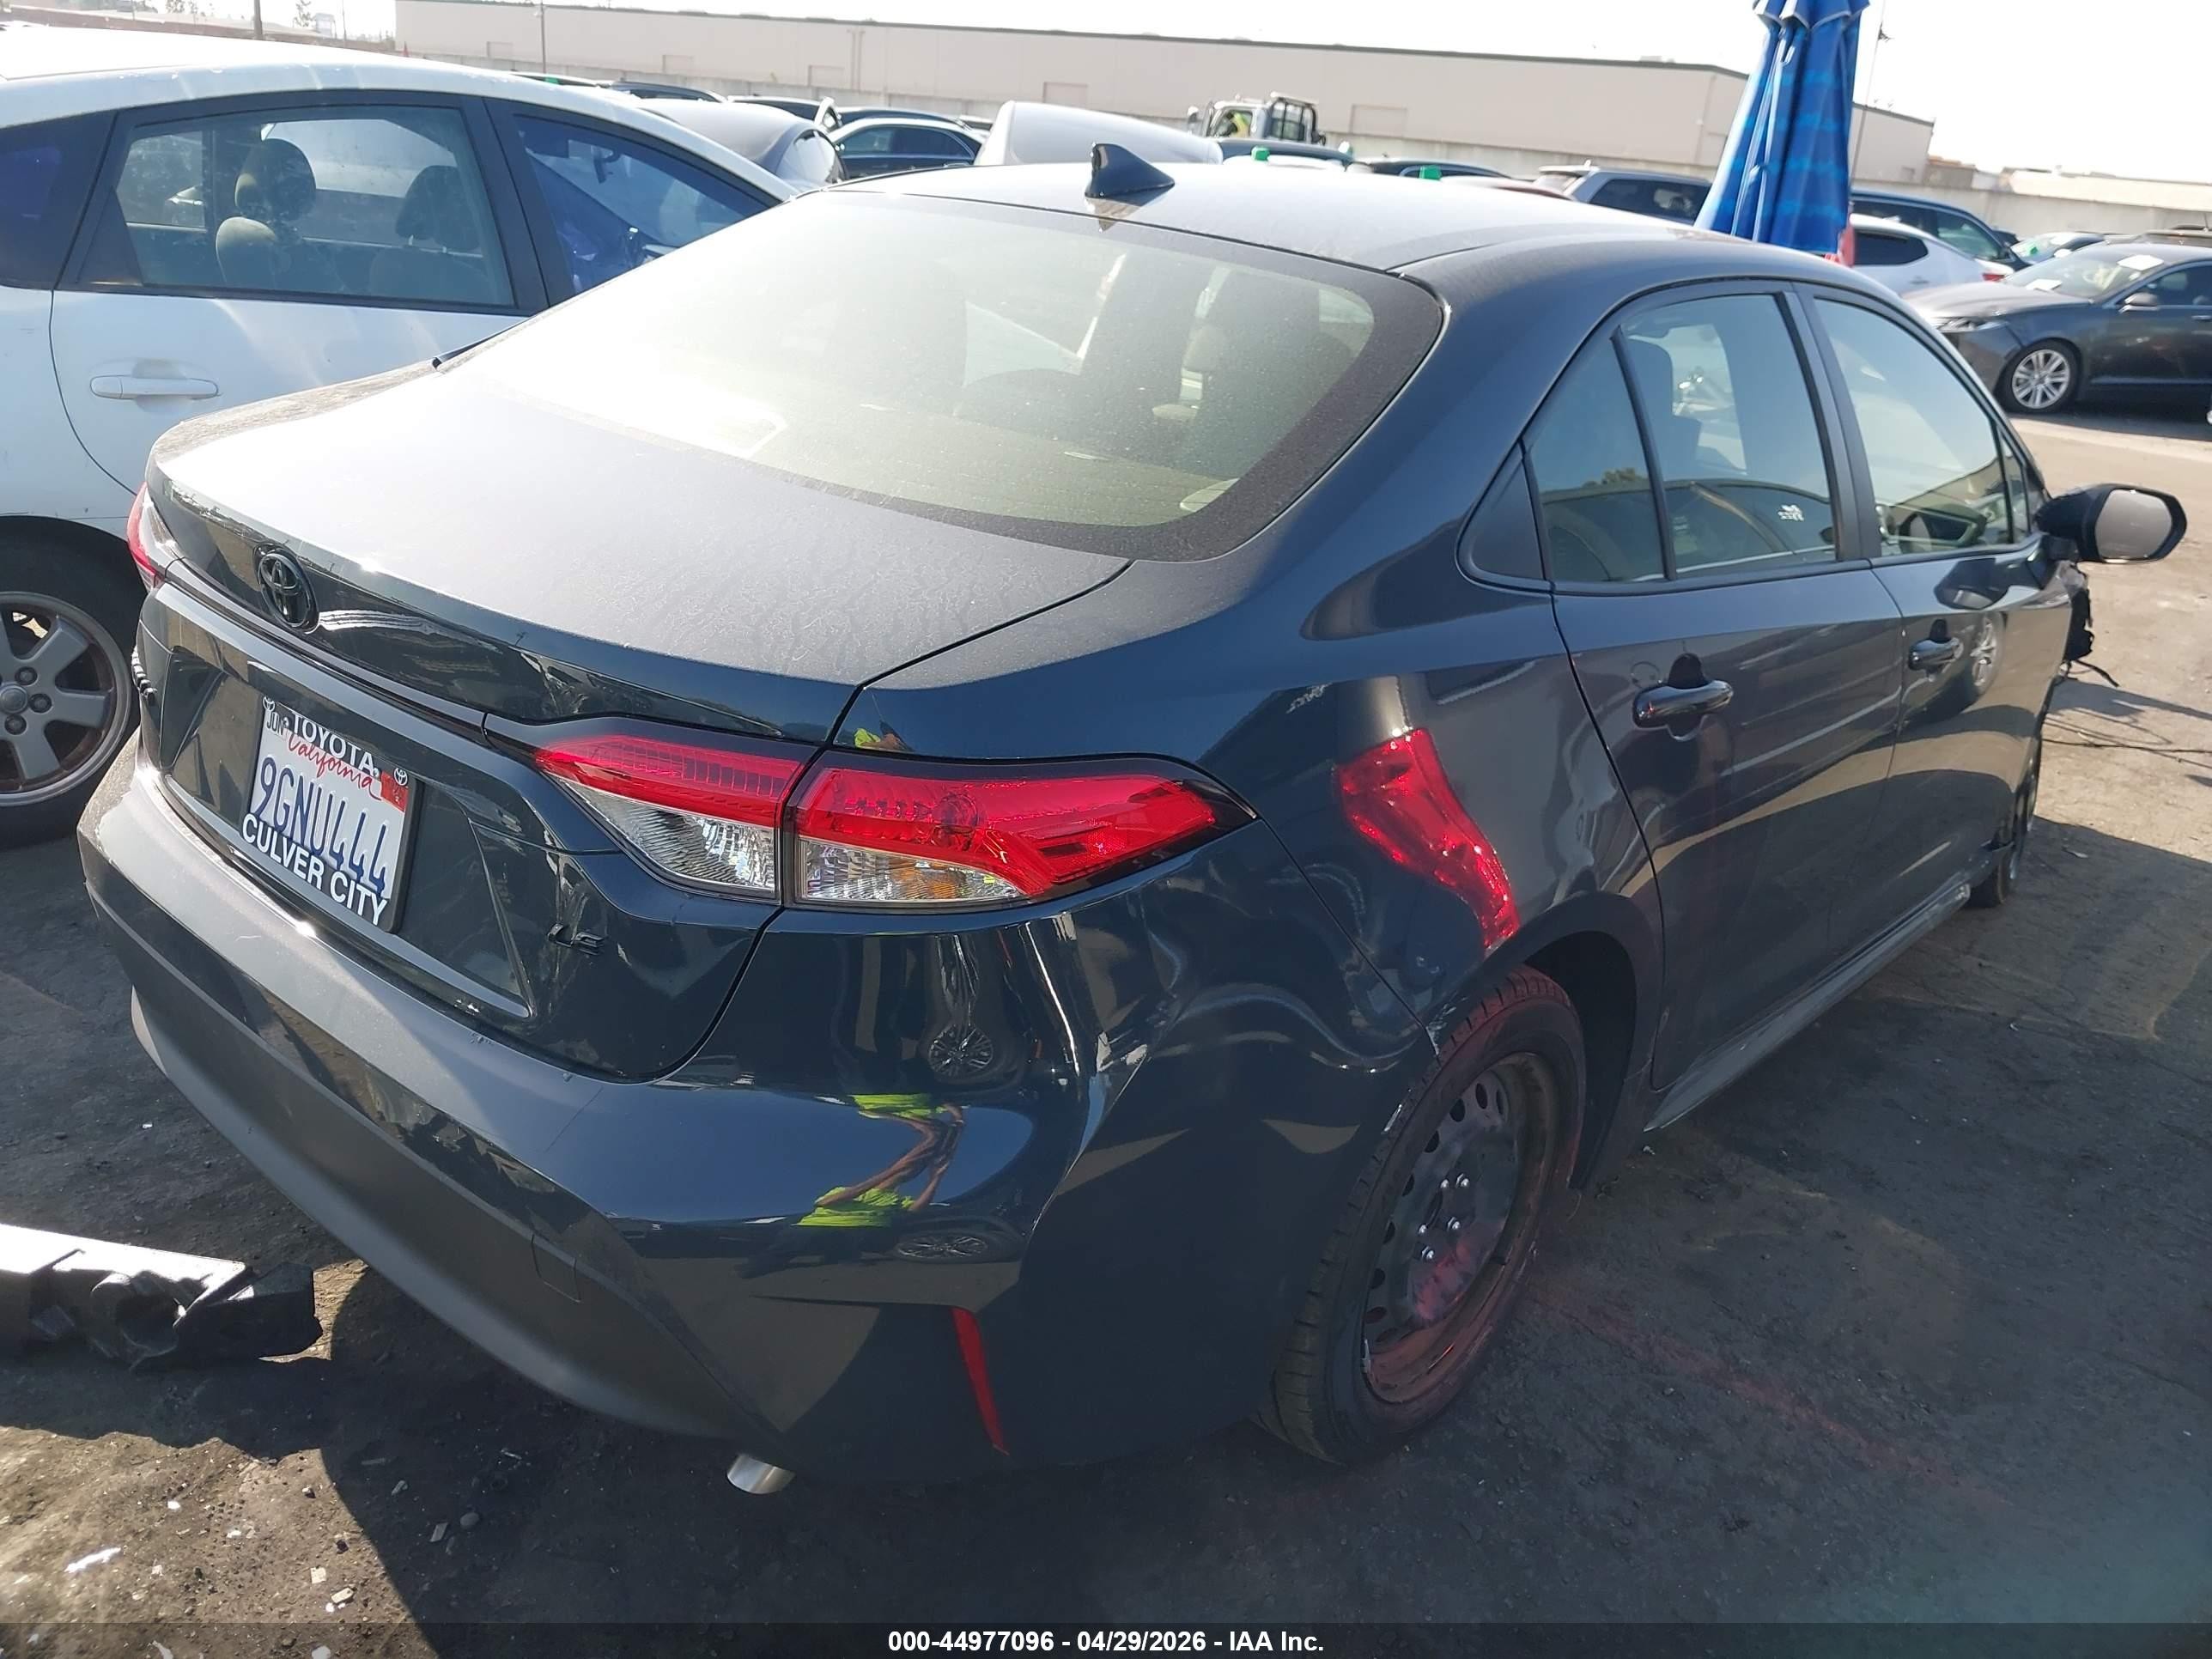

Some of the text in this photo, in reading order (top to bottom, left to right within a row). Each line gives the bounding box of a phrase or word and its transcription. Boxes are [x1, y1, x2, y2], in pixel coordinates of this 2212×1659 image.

[288, 732, 382, 801] California
[292, 711, 376, 777] TOYOTA
[242, 812, 388, 926] CULVER CITY
[257, 757, 387, 896] 9GNU444
